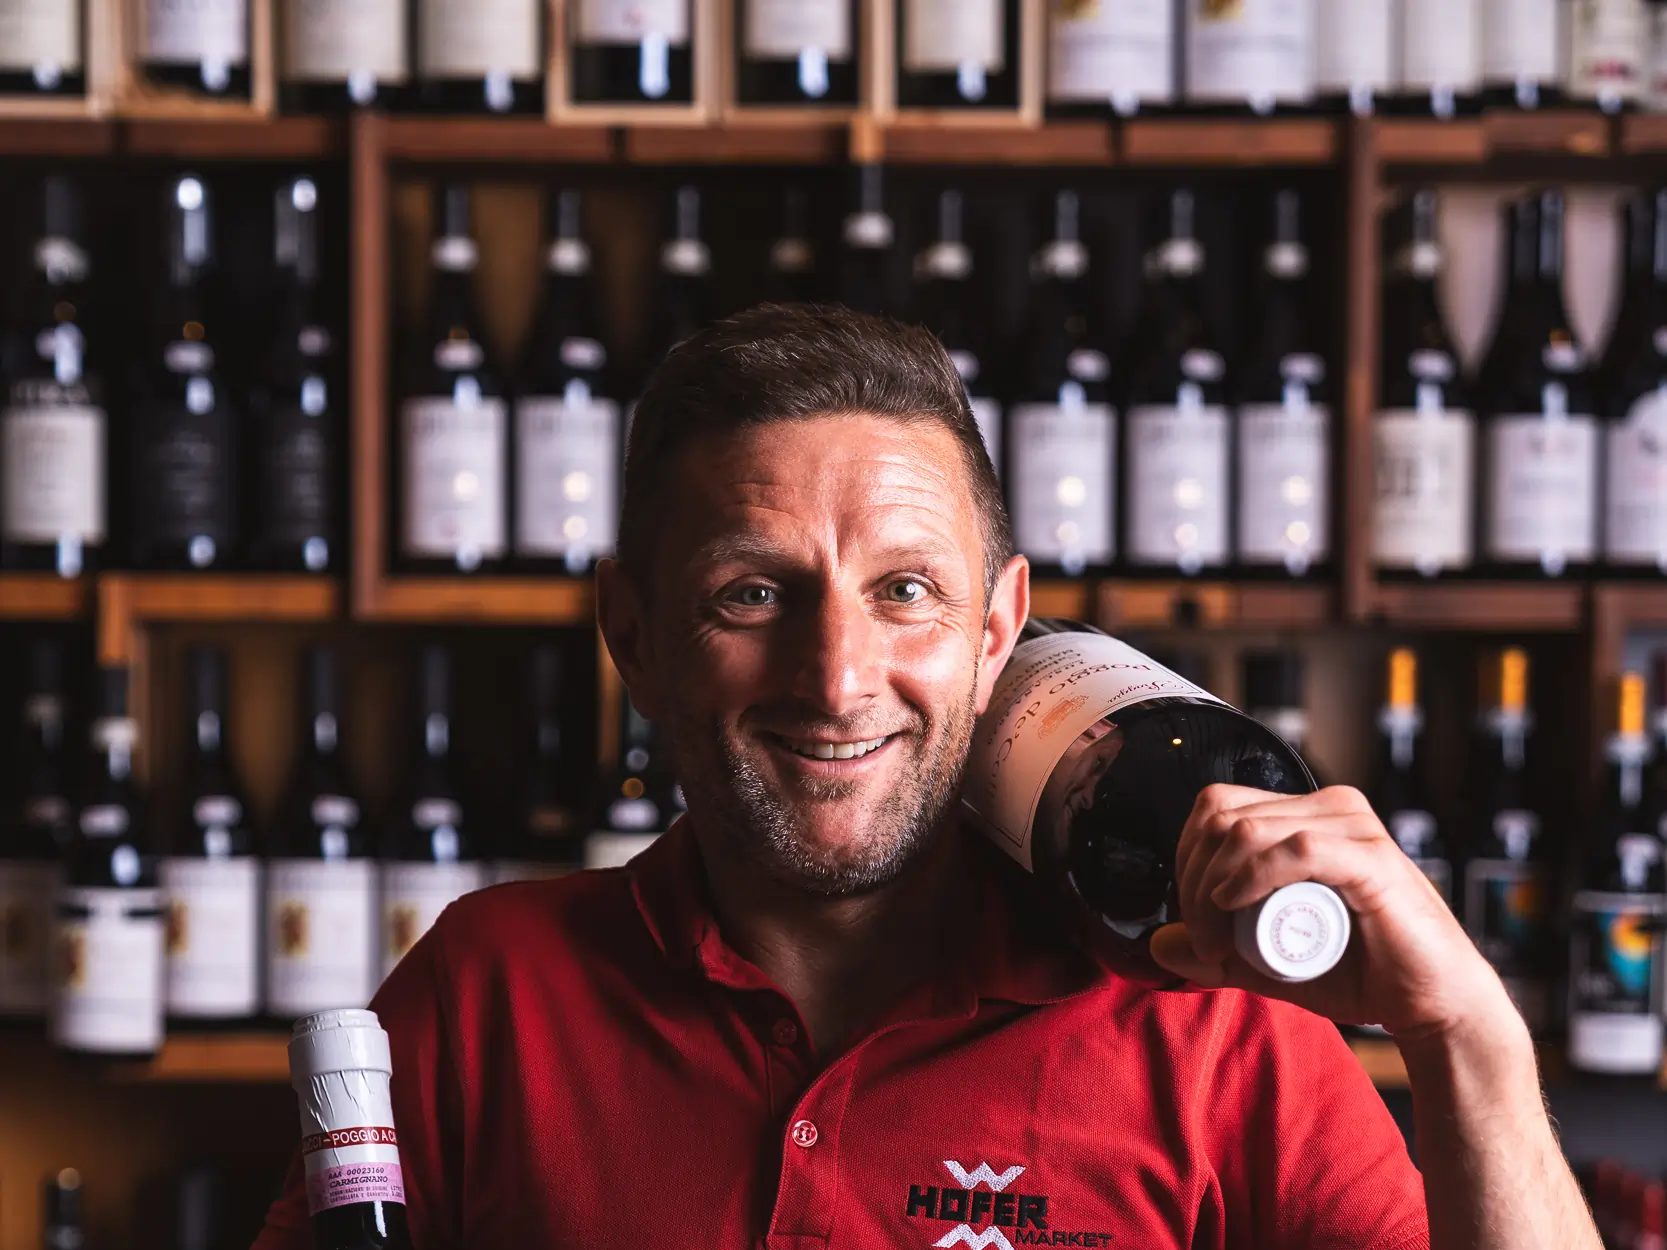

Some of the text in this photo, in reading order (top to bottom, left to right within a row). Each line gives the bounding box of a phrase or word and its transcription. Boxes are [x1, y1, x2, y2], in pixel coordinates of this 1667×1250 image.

[1048, 663, 1151, 694] Poggio
[331, 1129, 380, 1146] POGGIO
[381, 1129, 389, 1142] A
[346, 1167, 385, 1176] 00023160
[329, 1175, 388, 1189] CARMIGNANO
[906, 1184, 1049, 1229] HOFER
[1014, 1229, 1113, 1248] MARKET
